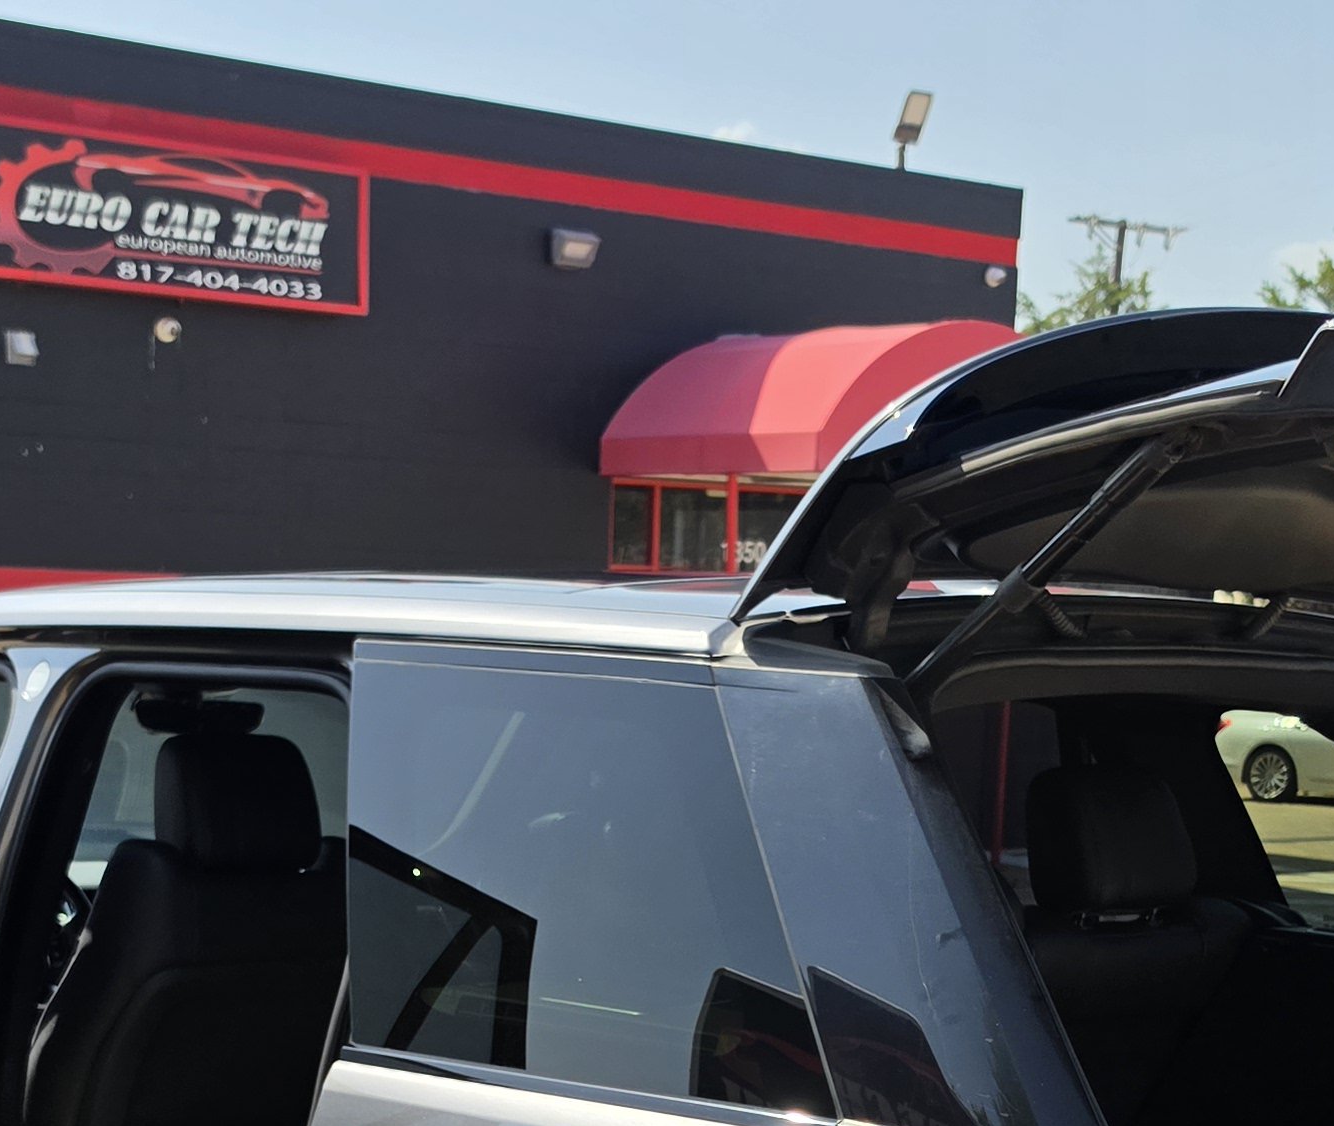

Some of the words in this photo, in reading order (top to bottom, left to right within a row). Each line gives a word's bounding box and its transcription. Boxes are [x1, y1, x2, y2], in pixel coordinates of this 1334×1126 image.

[18, 184, 132, 232] EURO
[142, 201, 221, 243] CAR
[231, 212, 329, 256] TECH
[115, 234, 210, 258] european
[214, 243, 323, 271] automotive
[115, 260, 323, 300] 817-404-4033
